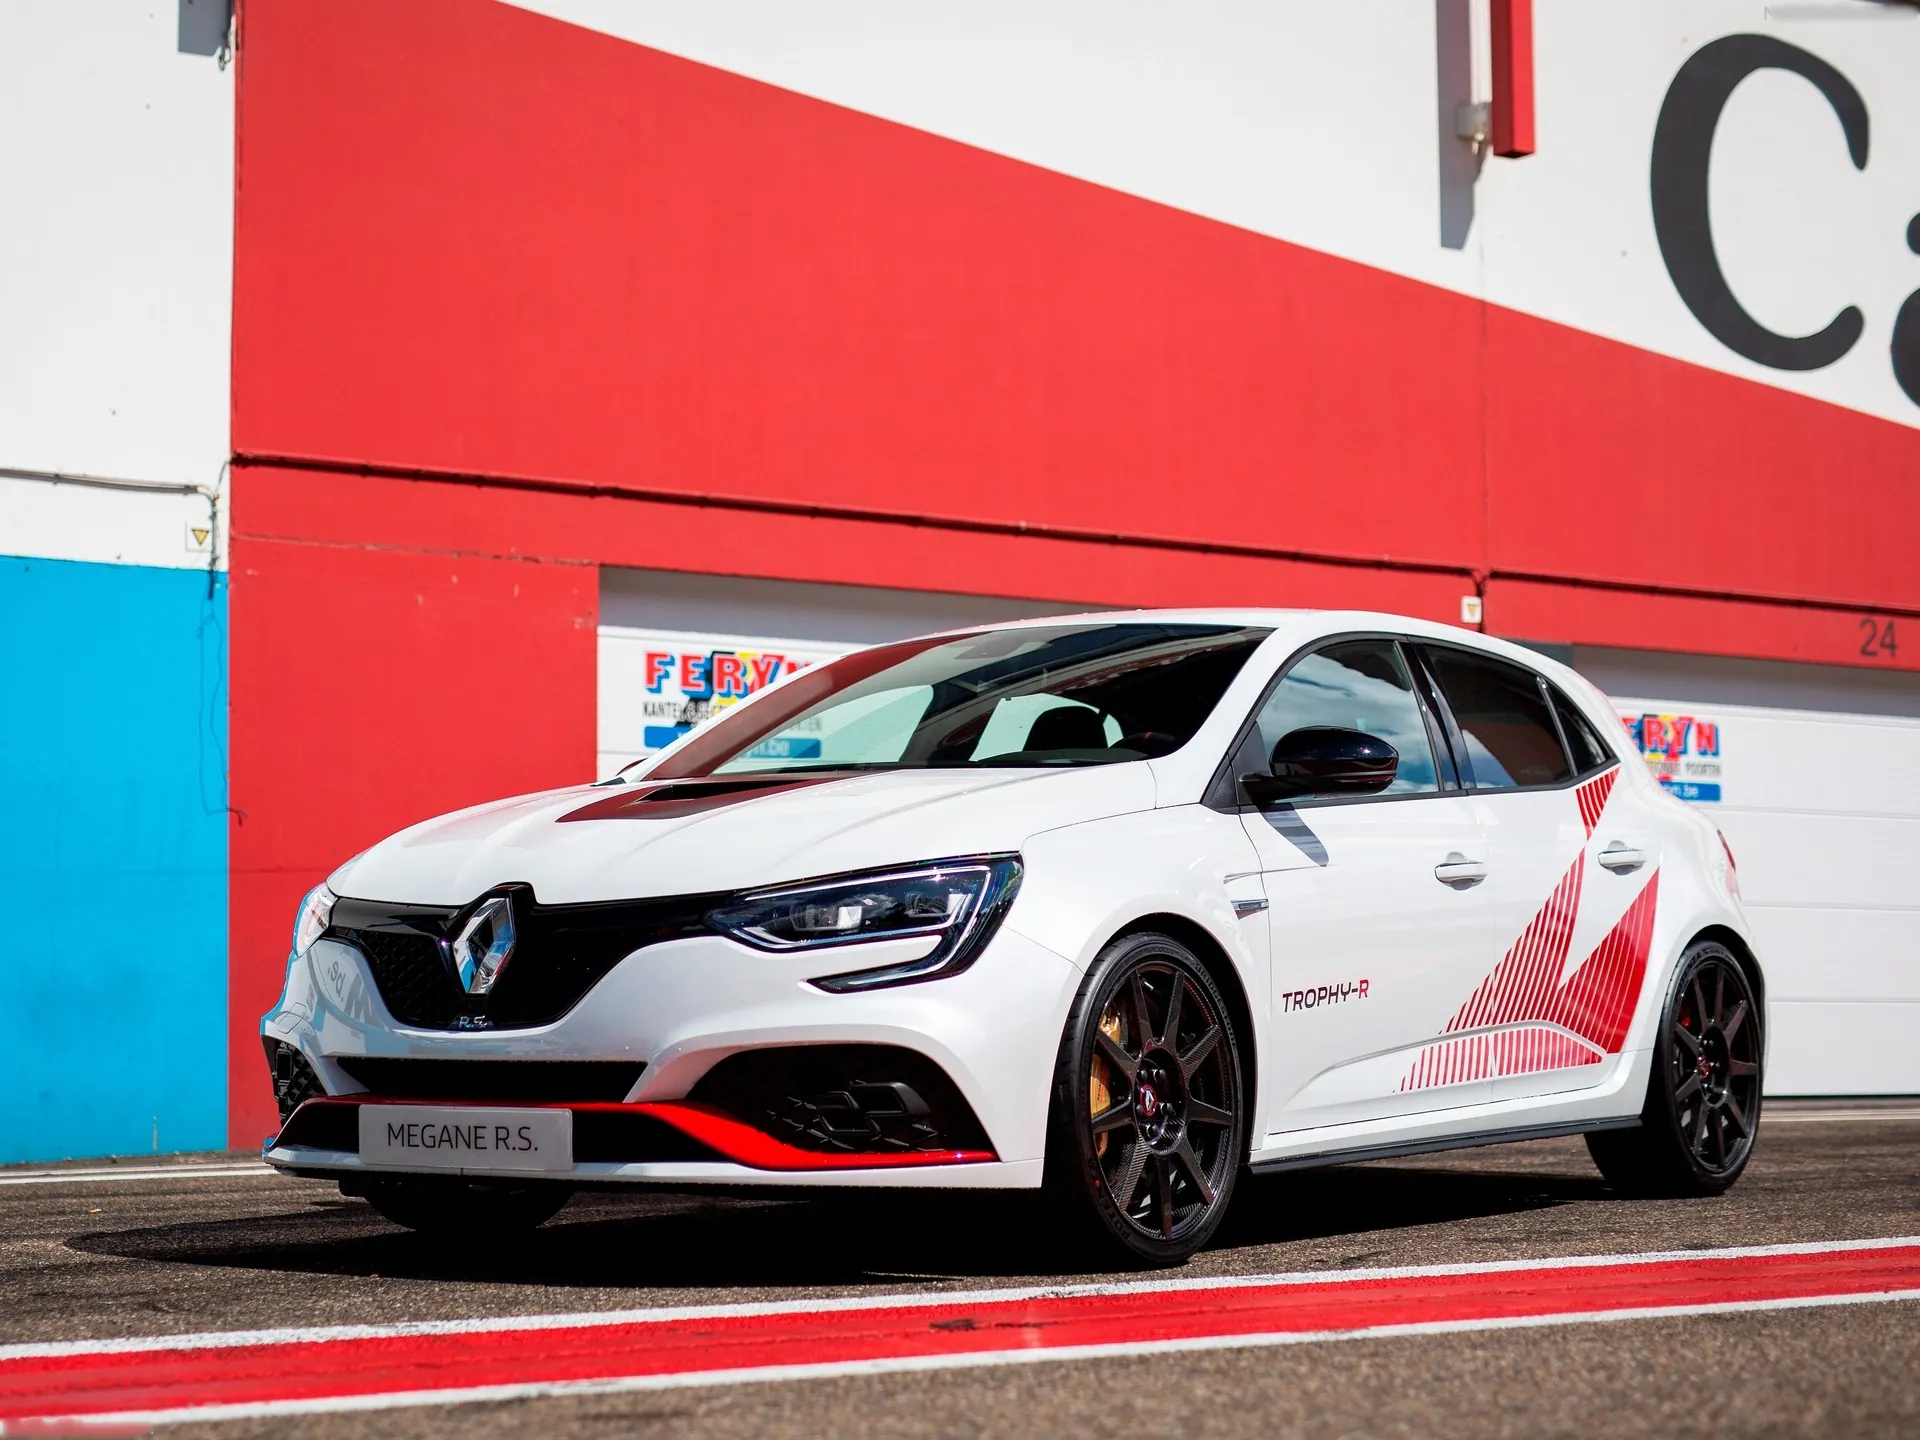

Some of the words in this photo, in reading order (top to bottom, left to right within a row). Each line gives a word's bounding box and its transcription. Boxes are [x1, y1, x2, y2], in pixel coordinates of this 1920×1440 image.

[1859, 617, 1899, 658] 24
[1282, 979, 1369, 1013] TROPHY-R
[387, 1123, 487, 1150] MEGANE
[495, 1126, 538, 1151] R.S.
